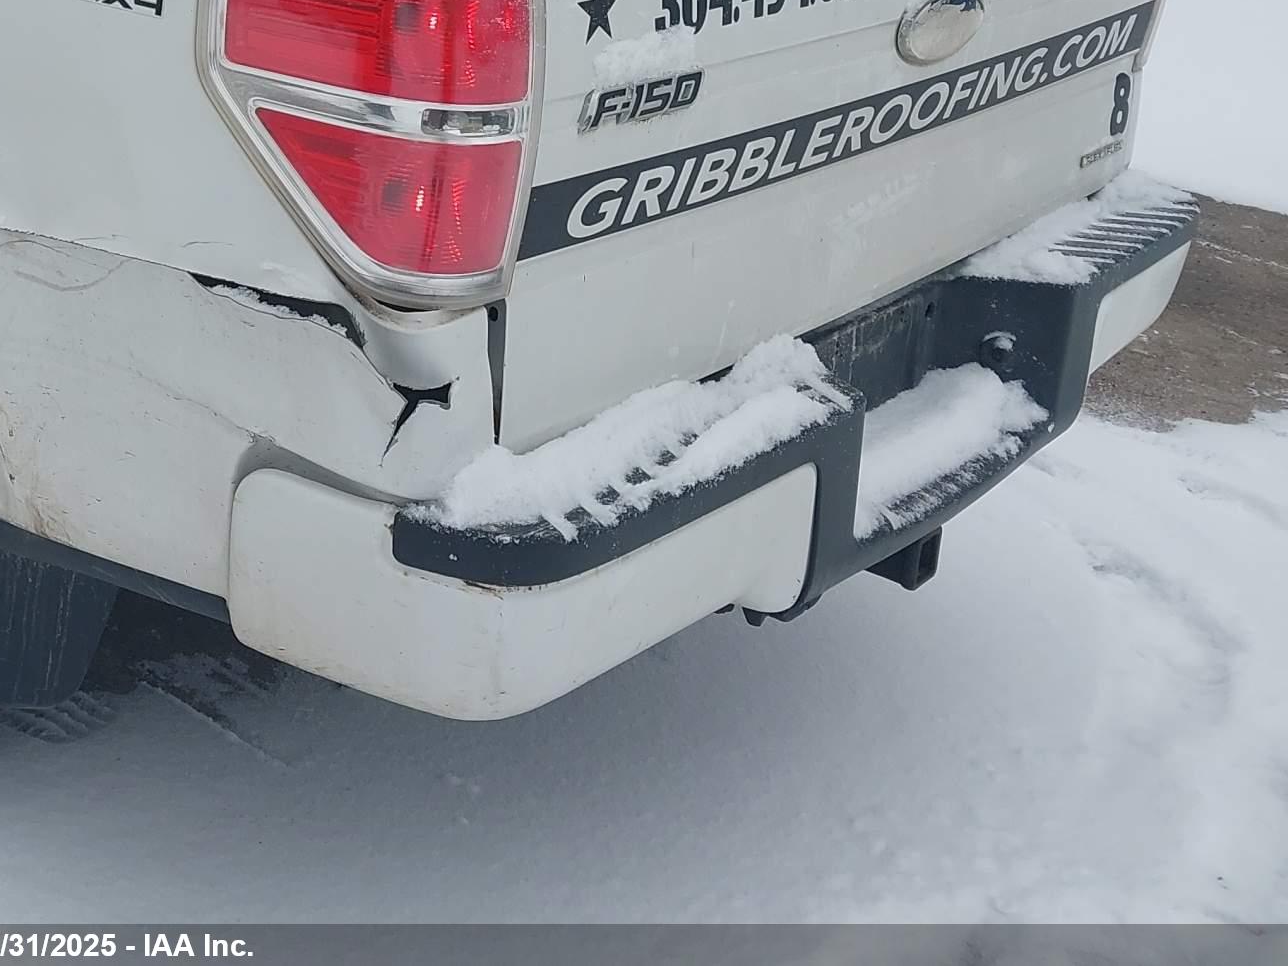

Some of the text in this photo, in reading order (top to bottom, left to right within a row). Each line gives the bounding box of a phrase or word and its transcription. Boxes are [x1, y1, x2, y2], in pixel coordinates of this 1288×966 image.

[566, 14, 1136, 239] GRIBBLEROOFING.COM
[584, 70, 704, 130] F-150
[1109, 71, 1131, 137] 8
